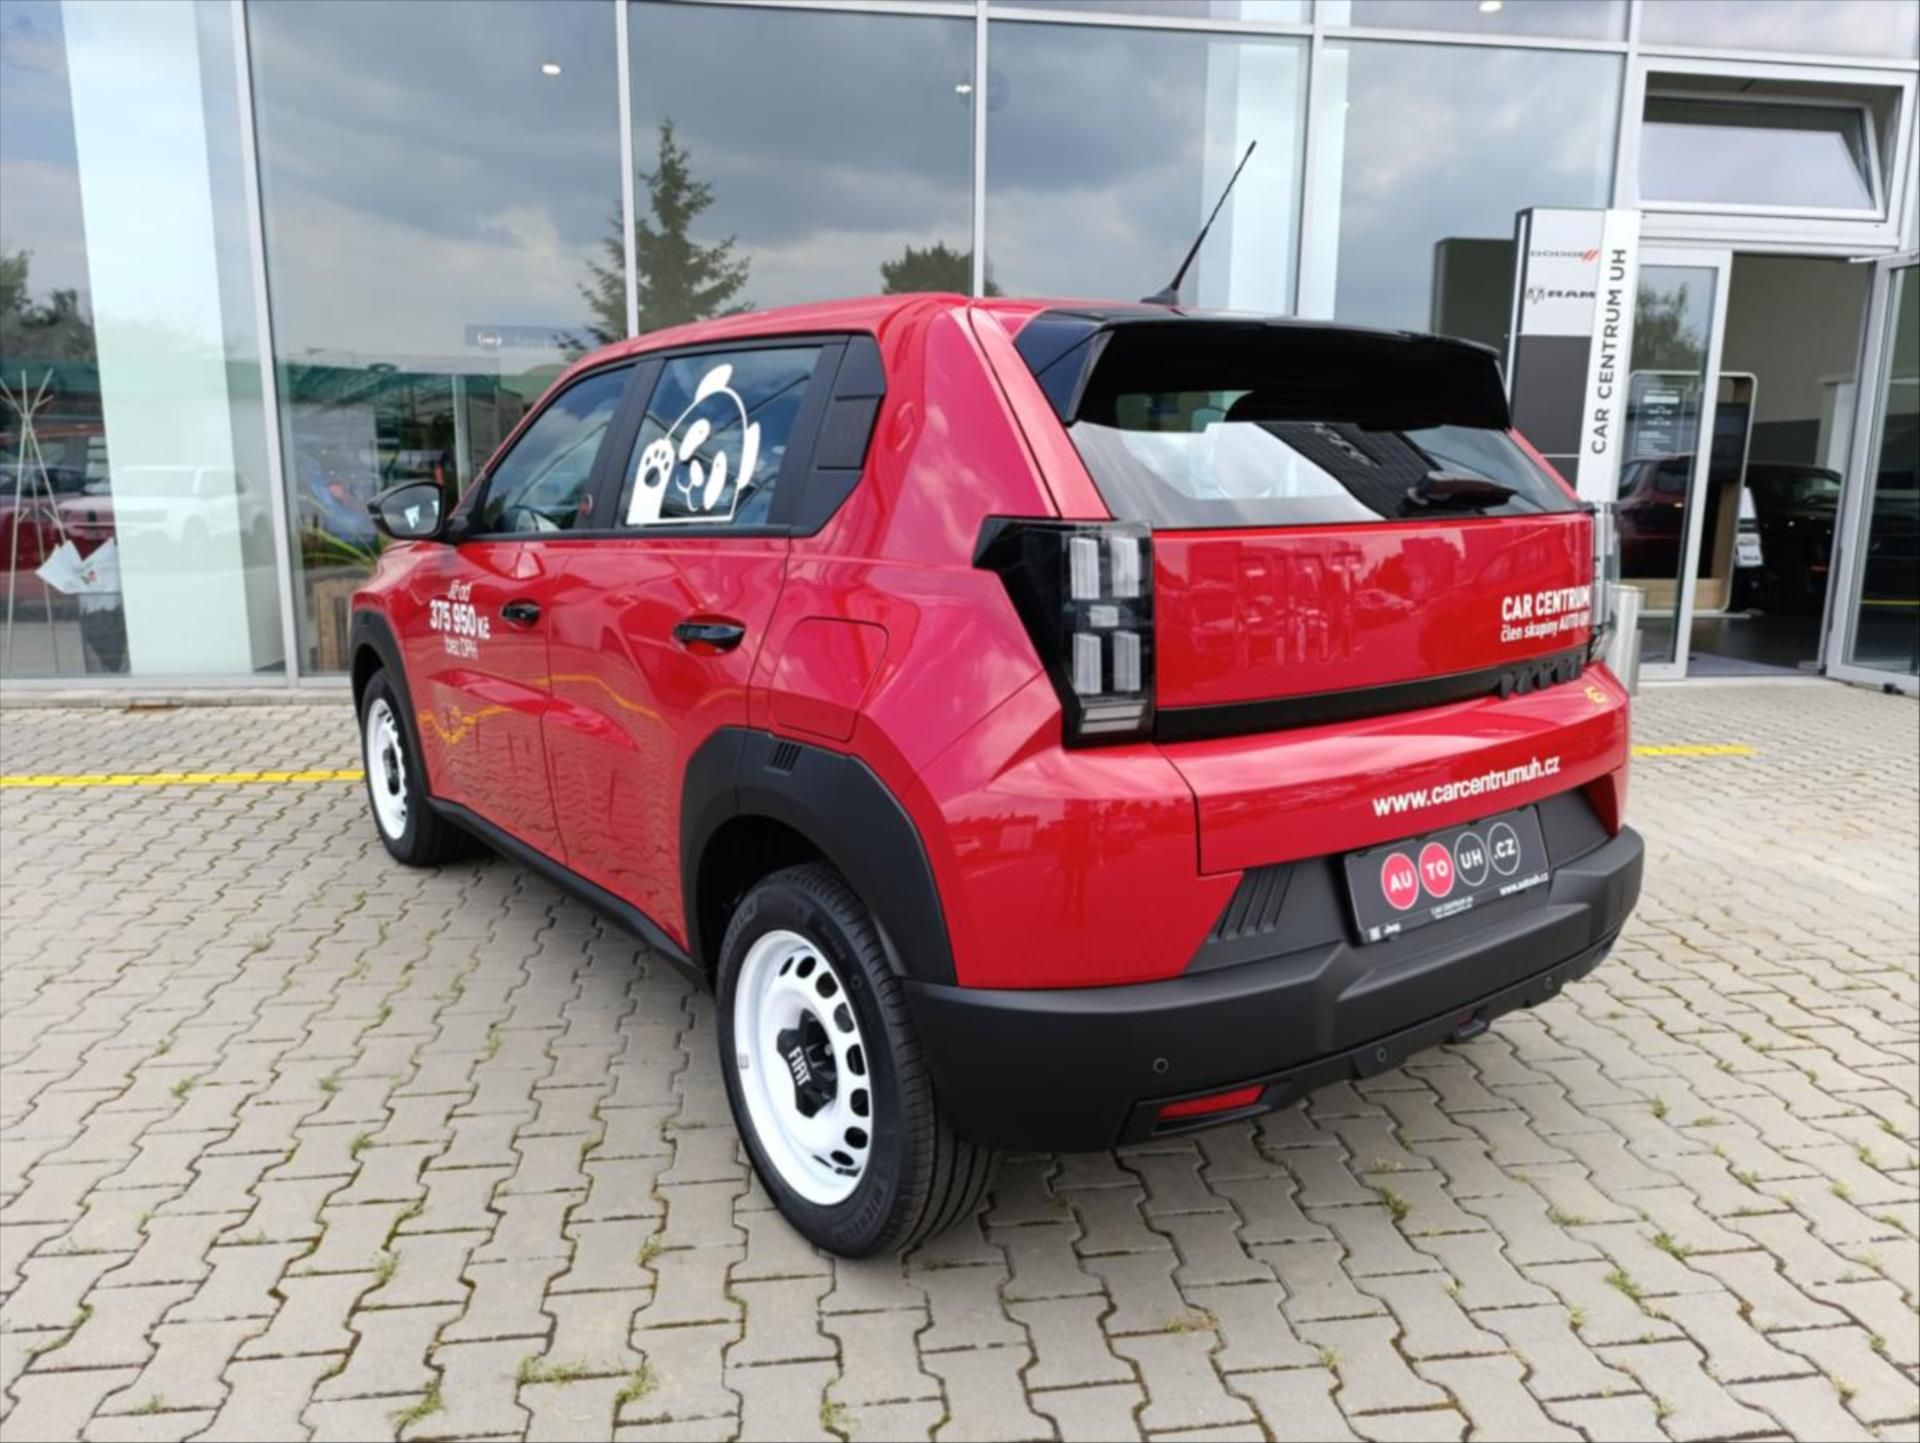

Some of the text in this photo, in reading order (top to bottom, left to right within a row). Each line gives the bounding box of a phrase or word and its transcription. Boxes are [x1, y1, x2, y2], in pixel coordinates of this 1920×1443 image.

[1547, 289, 1596, 299] RAM
[1592, 249, 1627, 454] CAR CENTRUM UH
[429, 599, 452, 632] 375
[452, 602, 477, 638] 950
[1502, 584, 1592, 621] CAR CENTRUM
[1524, 618, 1559, 639] skupiny
[1371, 756, 1561, 817] www.carcentrumuh.cz
[1389, 838, 1516, 893] AU TO UH .CZ
[788, 1047, 812, 1087] FIAT
